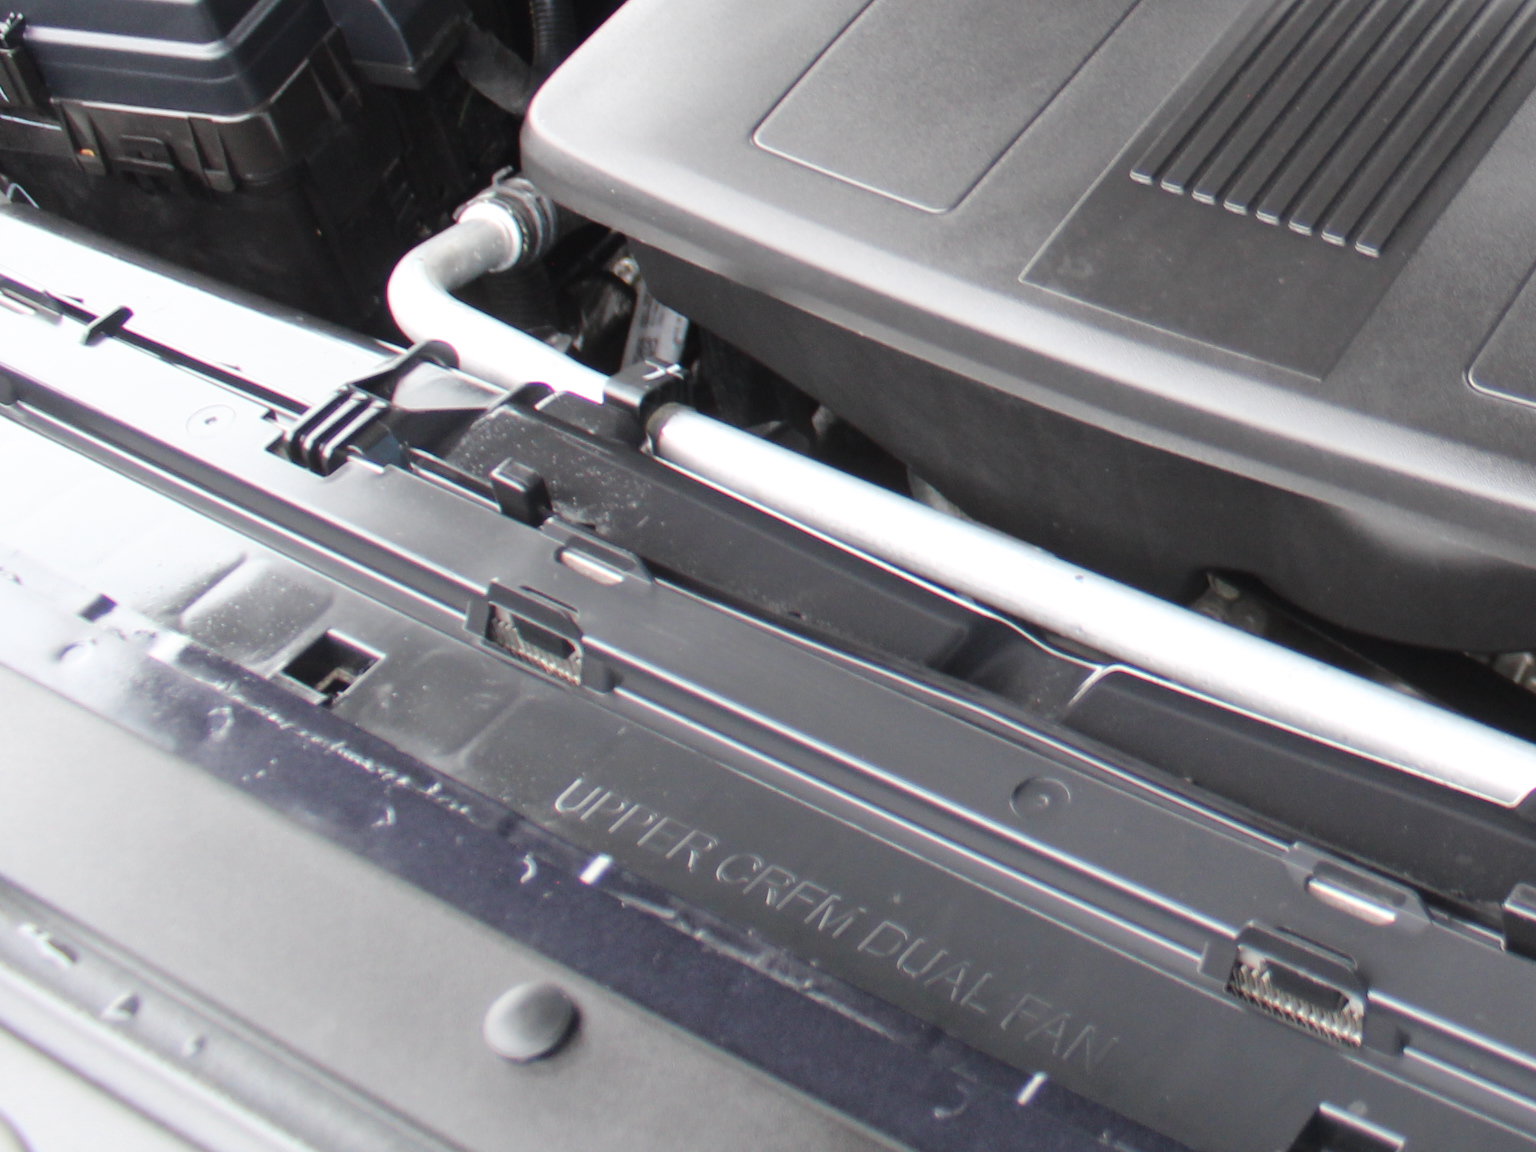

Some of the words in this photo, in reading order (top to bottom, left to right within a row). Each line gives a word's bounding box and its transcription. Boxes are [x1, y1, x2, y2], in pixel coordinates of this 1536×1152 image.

[555, 777, 719, 873] UPPER
[716, 853, 867, 939] CRFM
[857, 920, 993, 1014] DUAL
[1000, 993, 1120, 1075] FAN
